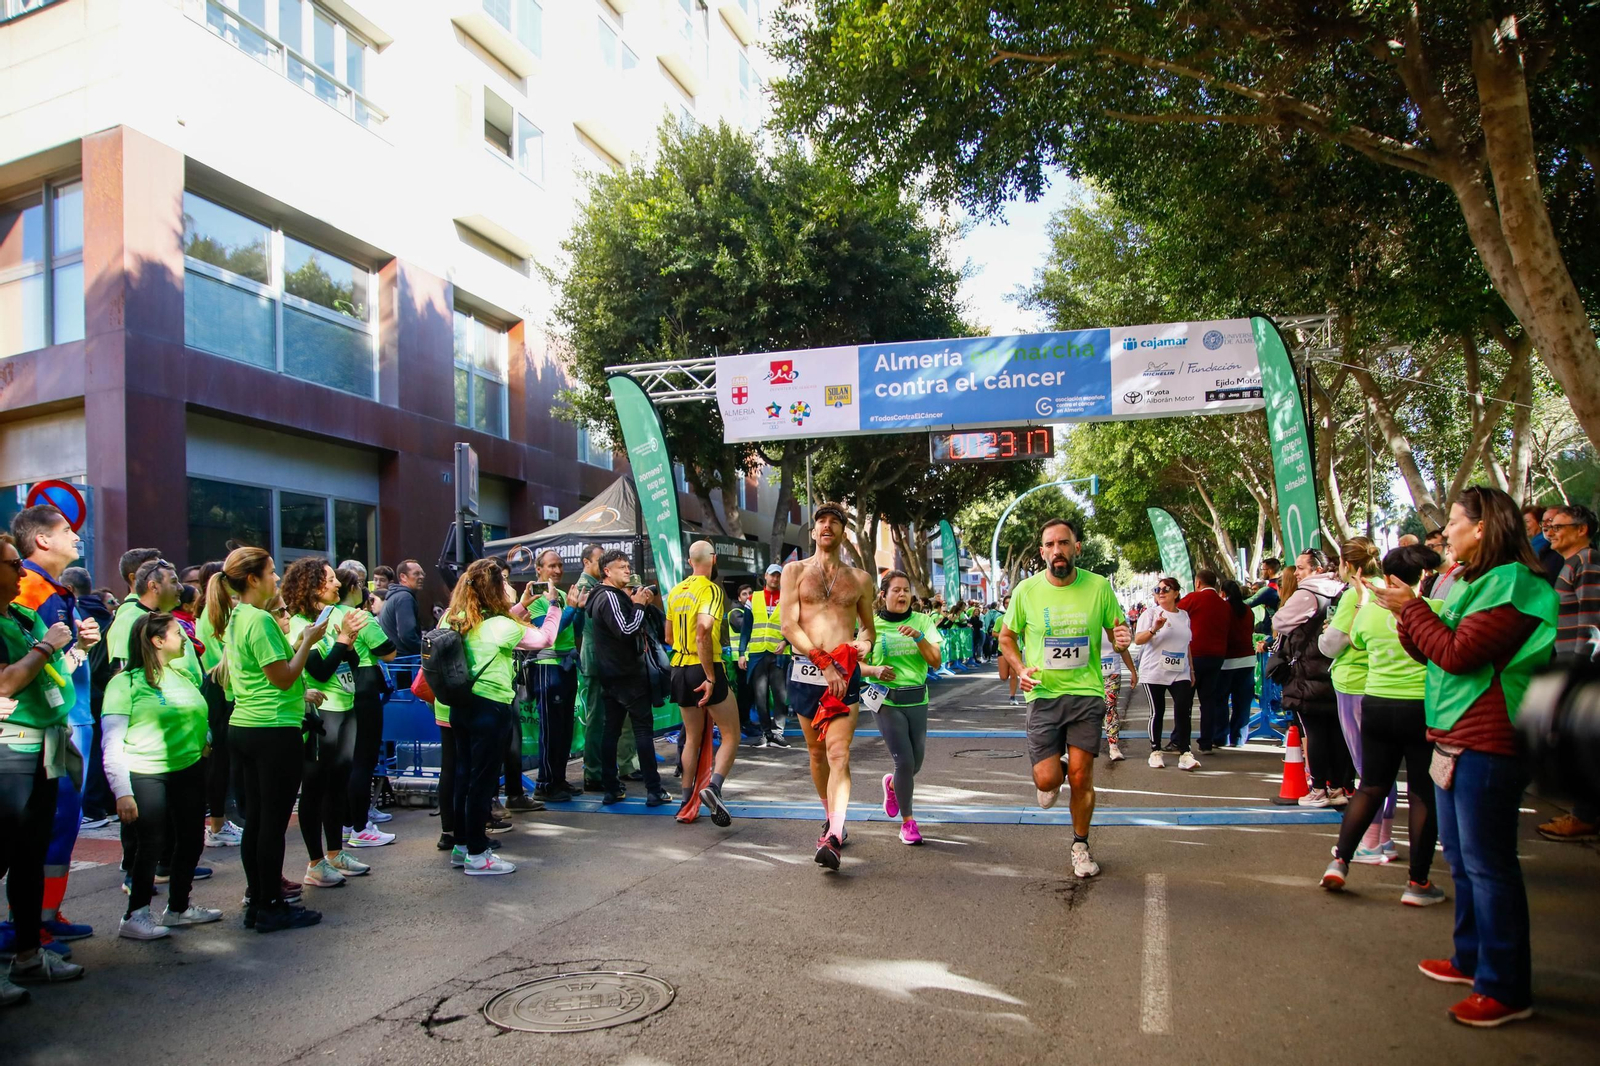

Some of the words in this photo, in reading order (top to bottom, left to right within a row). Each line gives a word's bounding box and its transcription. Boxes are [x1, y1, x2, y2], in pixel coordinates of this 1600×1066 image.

[1140, 337, 1188, 349] cajamar
[874, 348, 962, 372] Almería
[970, 350, 997, 364] en
[1004, 340, 1095, 361] marcha
[1187, 362, 1242, 374] Fundación
[874, 376, 948, 397] contra
[955, 372, 978, 392] el
[984, 370, 1065, 390] cáncer
[1216, 379, 1235, 388] Ejido
[828, 387, 848, 395] SOLAN
[725, 406, 755, 416] ALMERÍA
[870, 412, 943, 422] #TodosContraElCáncer
[1052, 619, 1078, 627] contra
[1053, 647, 1079, 659] 241
[1165, 657, 1180, 665] 904
[867, 688, 878, 700] 65
